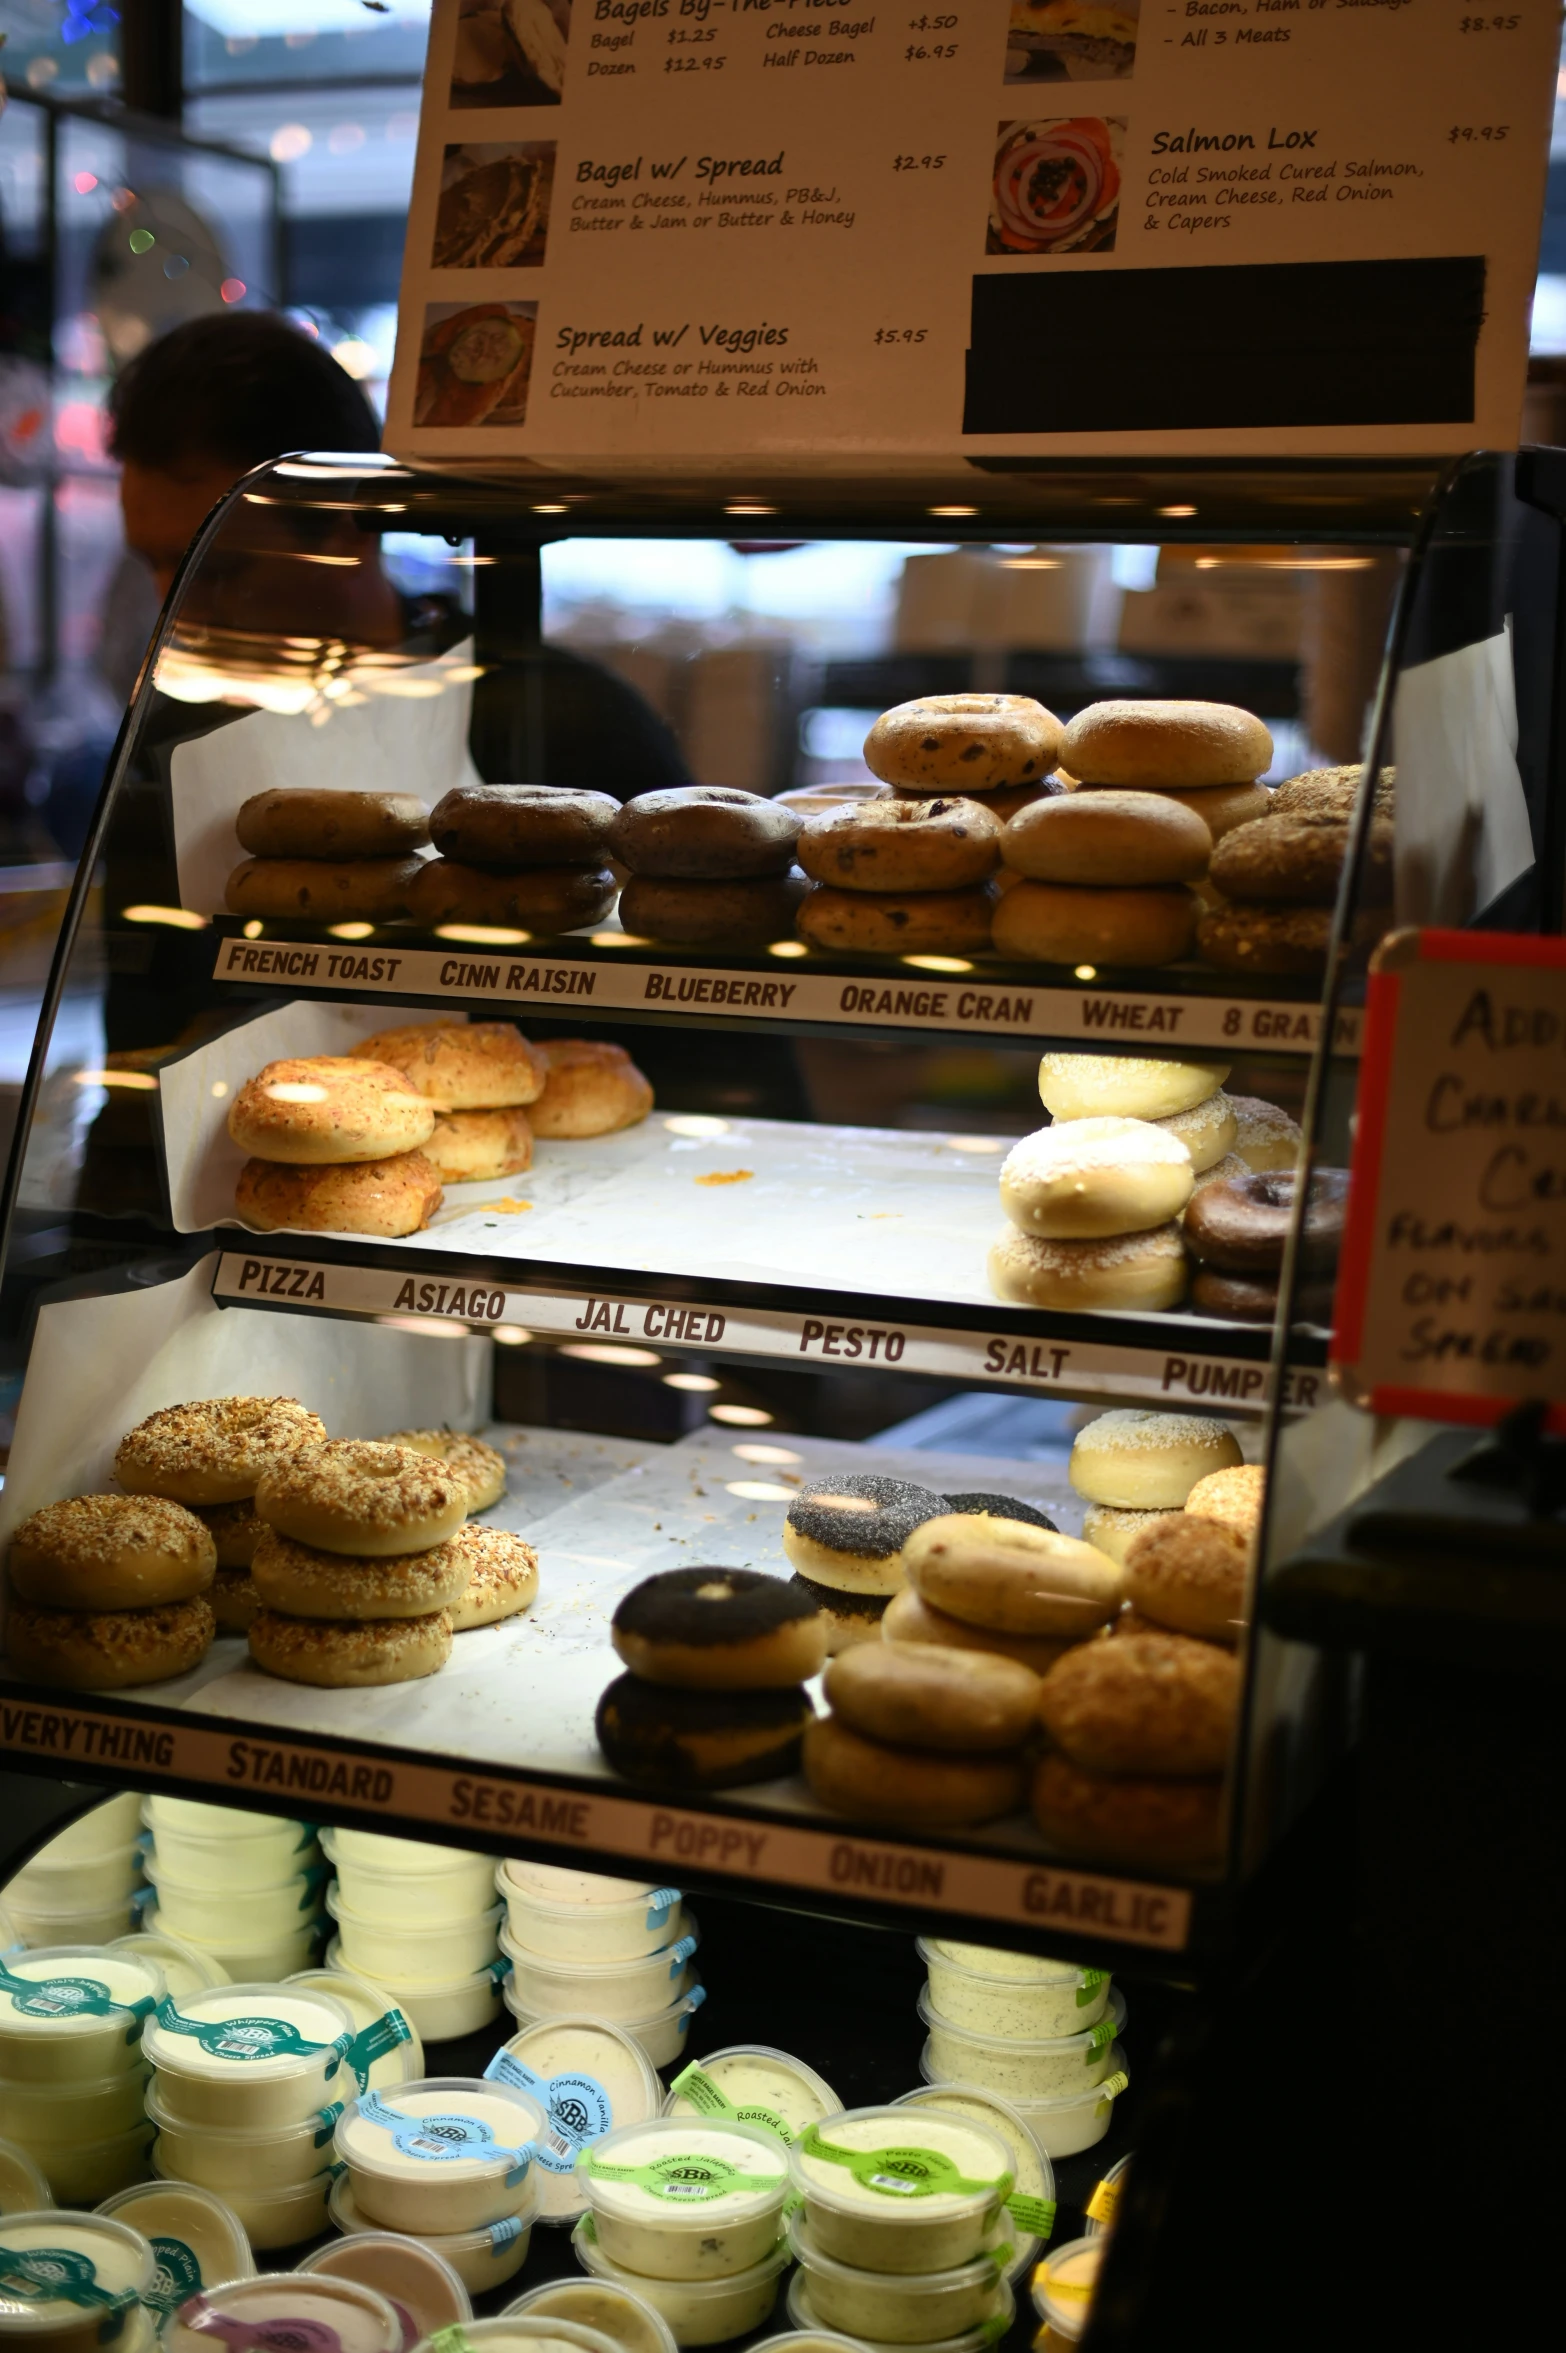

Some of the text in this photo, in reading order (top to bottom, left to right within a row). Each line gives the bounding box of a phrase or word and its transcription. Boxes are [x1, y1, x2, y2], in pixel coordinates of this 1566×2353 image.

[594, 0, 669, 25] Bagels
[1185, 0, 1248, 17] Bacon,
[766, 14, 959, 39] Cheese Bagel +$.50
[1181, 28, 1208, 46] All
[1214, 31, 1227, 45] 3
[1235, 27, 1291, 45] Meats
[1459, 15, 1522, 33] $8.95
[591, 28, 718, 52] Bagel $1.25
[587, 56, 728, 76] Dozen $12.95
[763, 43, 959, 67] Half Dozen $6.95
[1151, 125, 1510, 155] Salmon Lox $9.95
[574, 150, 948, 186] Bagel w/ Spread $2.95
[1147, 159, 1425, 186] Cold Smoked Cured Salmon,
[571, 186, 842, 212] Cream Cheese, Hummus, PB&J,
[1145, 182, 1394, 208] Cream Cheese, Red Onion
[569, 206, 856, 232] Butter & Jam or Butter & Honey
[1143, 211, 1232, 235] & Capers
[556, 321, 929, 354] Spread w/ Veggies $5.95
[552, 357, 819, 378] Cream Cheese or Hummus with
[549, 379, 827, 400] Cucumber, Tomato & Red Onion
[226, 945, 402, 983] FRENCH TOAST
[439, 960, 597, 995] CINN RAISIN
[644, 972, 797, 1008] BLUEBERRY
[839, 984, 1034, 1023] ORANGE CRAN
[1081, 999, 1185, 1033] WHEAT
[1221, 1006, 1358, 1046] 8 GRAN
[238, 1259, 326, 1300] PIZZA
[393, 1278, 506, 1320] ASIAGO
[575, 1298, 727, 1343] JAL CHED
[799, 1319, 907, 1362] PESTO
[983, 1339, 1071, 1379] SALT
[226, 1740, 393, 1802] STANDARD
[449, 1779, 592, 1839] SESAME
[648, 1812, 770, 1868] POPPY
[828, 1843, 946, 1899] ONION
[1021, 1873, 1169, 1936] GARLIC
[225, 2018, 295, 2038] Whipped Plain
[236, 2027, 274, 2043] SBB
[244, 2051, 276, 2060] Spread
[549, 2079, 596, 2096] Cinnamon
[596, 2095, 609, 2133] Vanilla
[554, 2100, 588, 2132] SBB
[422, 2117, 475, 2126] Cinnamon
[736, 2111, 781, 2129] Roasted
[432, 2127, 467, 2143] SBB
[649, 2156, 691, 2171] Roasted
[670, 2168, 712, 2181] SBB
[178, 2254, 197, 2283] Plain
